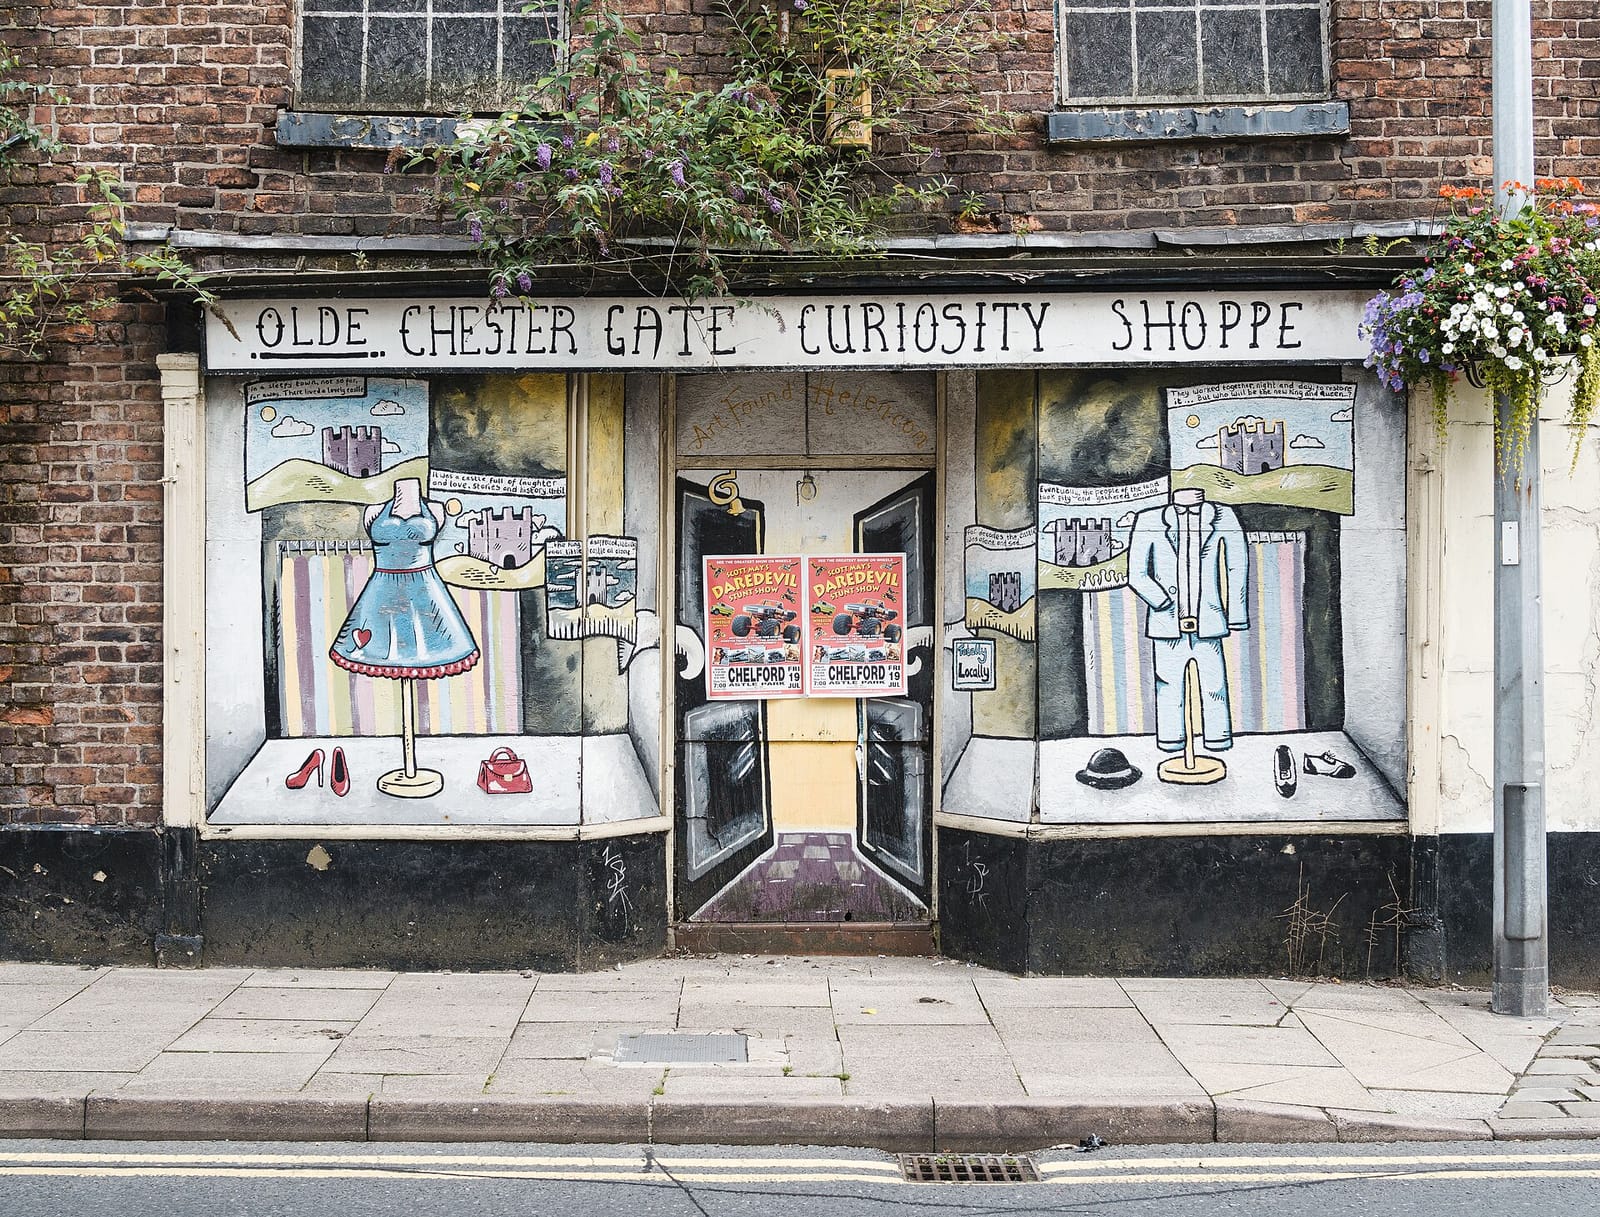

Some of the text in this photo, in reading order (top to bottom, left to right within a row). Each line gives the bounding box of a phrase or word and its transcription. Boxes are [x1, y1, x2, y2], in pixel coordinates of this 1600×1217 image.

[255, 299, 1304, 361] OLDE CHESTER GATE CURIOSITY SHOPPE
[282, 389, 304, 397] There
[1170, 391, 1190, 399] They
[1256, 381, 1276, 390] night
[1279, 381, 1294, 389] and
[1247, 388, 1257, 396] be
[489, 477, 504, 485] full
[507, 478, 517, 487] of
[518, 478, 557, 489] laughter
[503, 485, 518, 493] and
[1095, 487, 1119, 498] people
[1120, 486, 1129, 494] of
[1143, 480, 1160, 489] land
[1096, 491, 1130, 504] gathered
[979, 530, 1004, 541] decades
[1006, 533, 1017, 541] the
[726, 563, 770, 578] SCOTT MAY'S
[827, 563, 872, 577] SCOTT MAY'S
[711, 571, 798, 600] DAREDEVIL
[813, 570, 899, 599] DAREDEVIL
[728, 586, 779, 603] STUNT SHOW
[830, 584, 880, 601] STUNT SHOW
[728, 666, 786, 683] CHELFORD
[788, 672, 800, 682] 19
[828, 665, 886, 681] CHELFORD
[888, 671, 901, 681] 19
[958, 662, 990, 682] Locally
